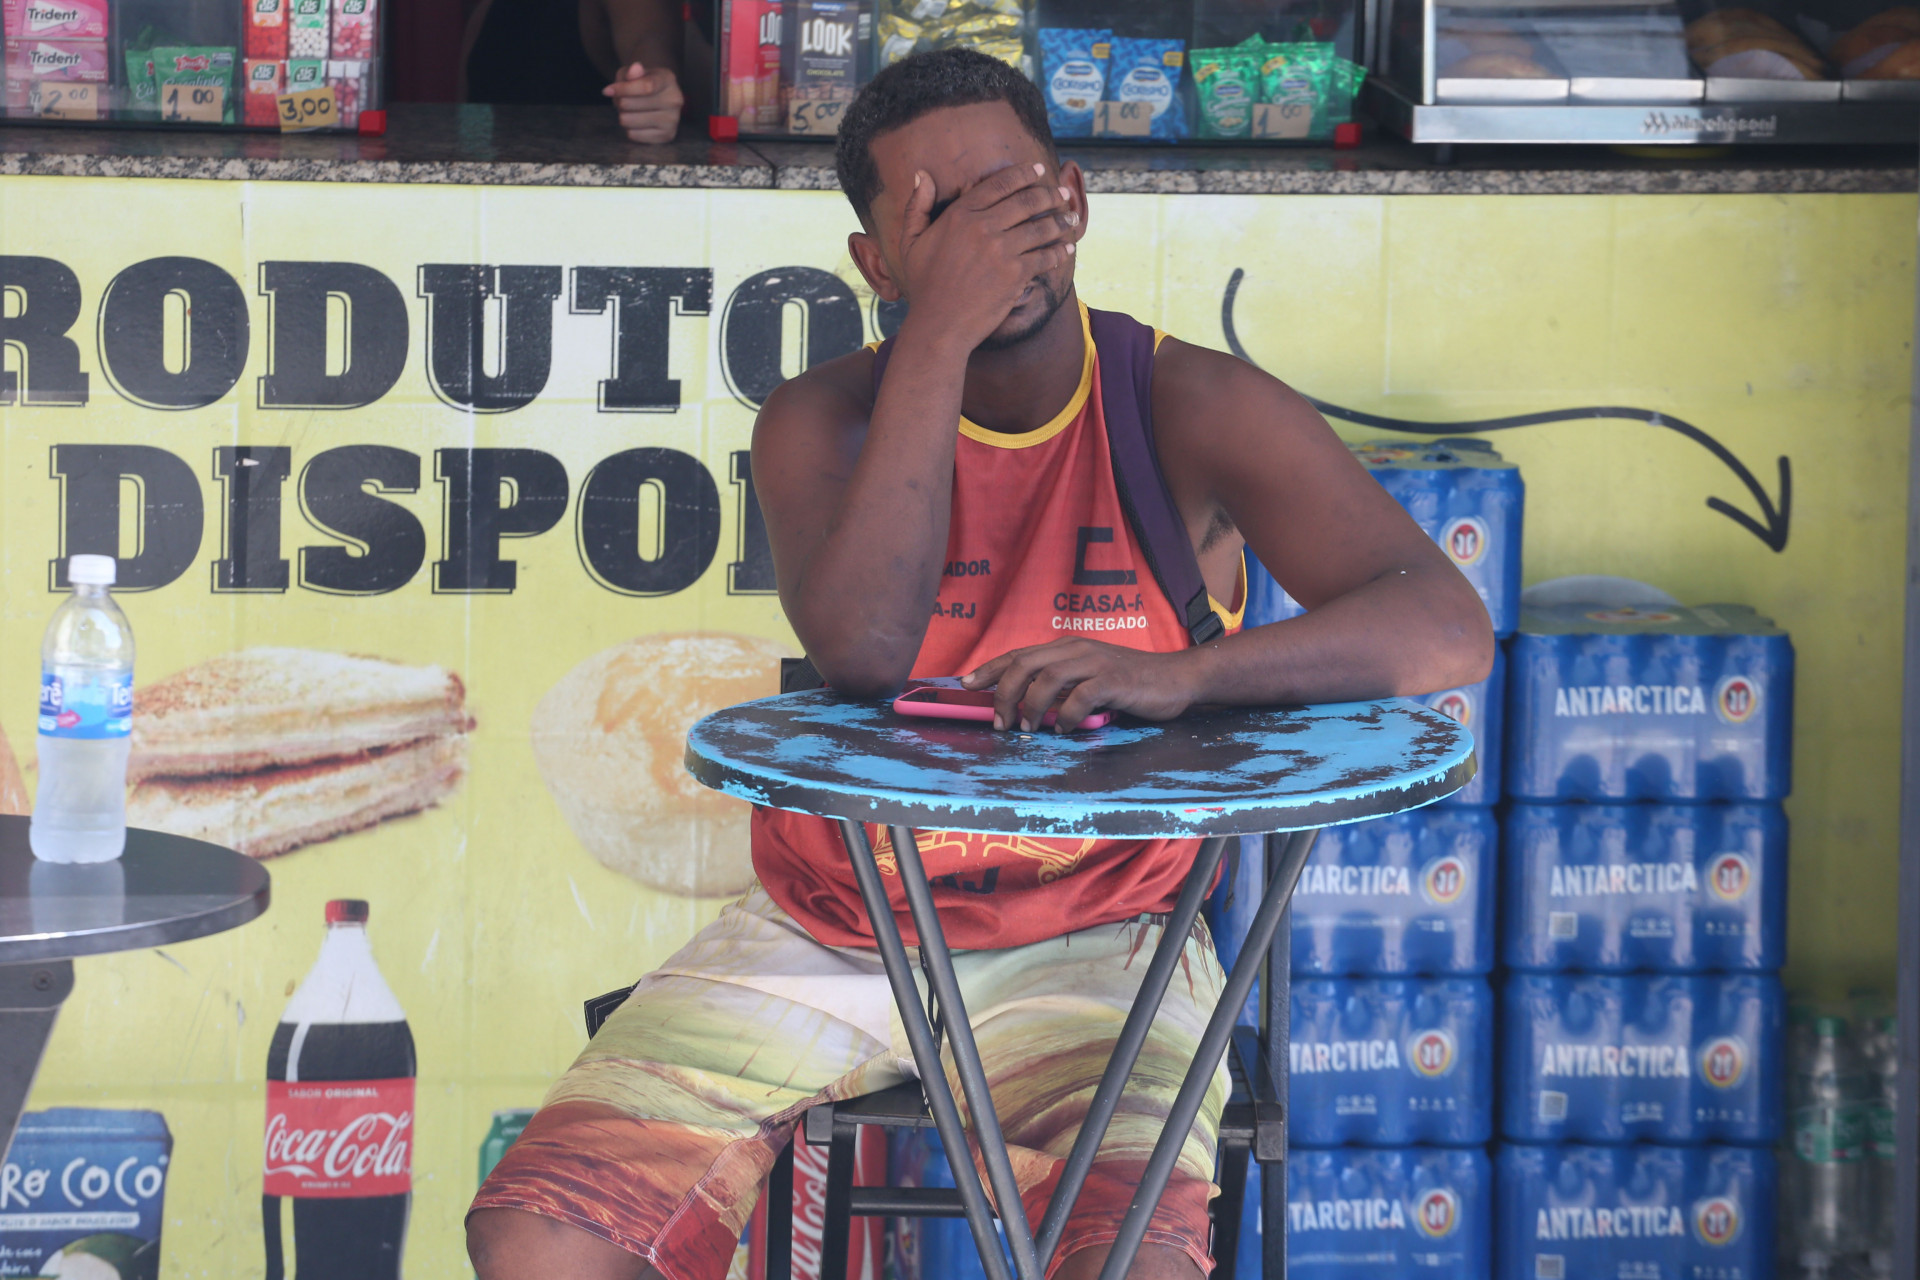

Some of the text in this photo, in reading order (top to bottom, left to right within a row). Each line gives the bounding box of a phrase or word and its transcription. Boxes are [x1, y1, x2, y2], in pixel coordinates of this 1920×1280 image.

[28, 8, 78, 20] Trident
[801, 18, 853, 56] LOOK
[30, 51, 80, 64] Trident
[279, 97, 330, 122] 3,00
[0, 255, 908, 414] RODUTO
[1052, 615, 1149, 631] CARREGADO
[1555, 685, 1706, 717] ANTARCTICA
[1292, 864, 1410, 896] TARCTICA
[1550, 862, 1698, 896] ANTARCTICA
[1541, 1044, 1690, 1078] ANTARCTICA
[289, 1086, 378, 1098] SABOR ORIGINAL
[264, 1110, 412, 1178] Coca-Cola
[1257, 1199, 1405, 1234] TARCTICA
[1536, 1206, 1685, 1239] ANTARCTICA
